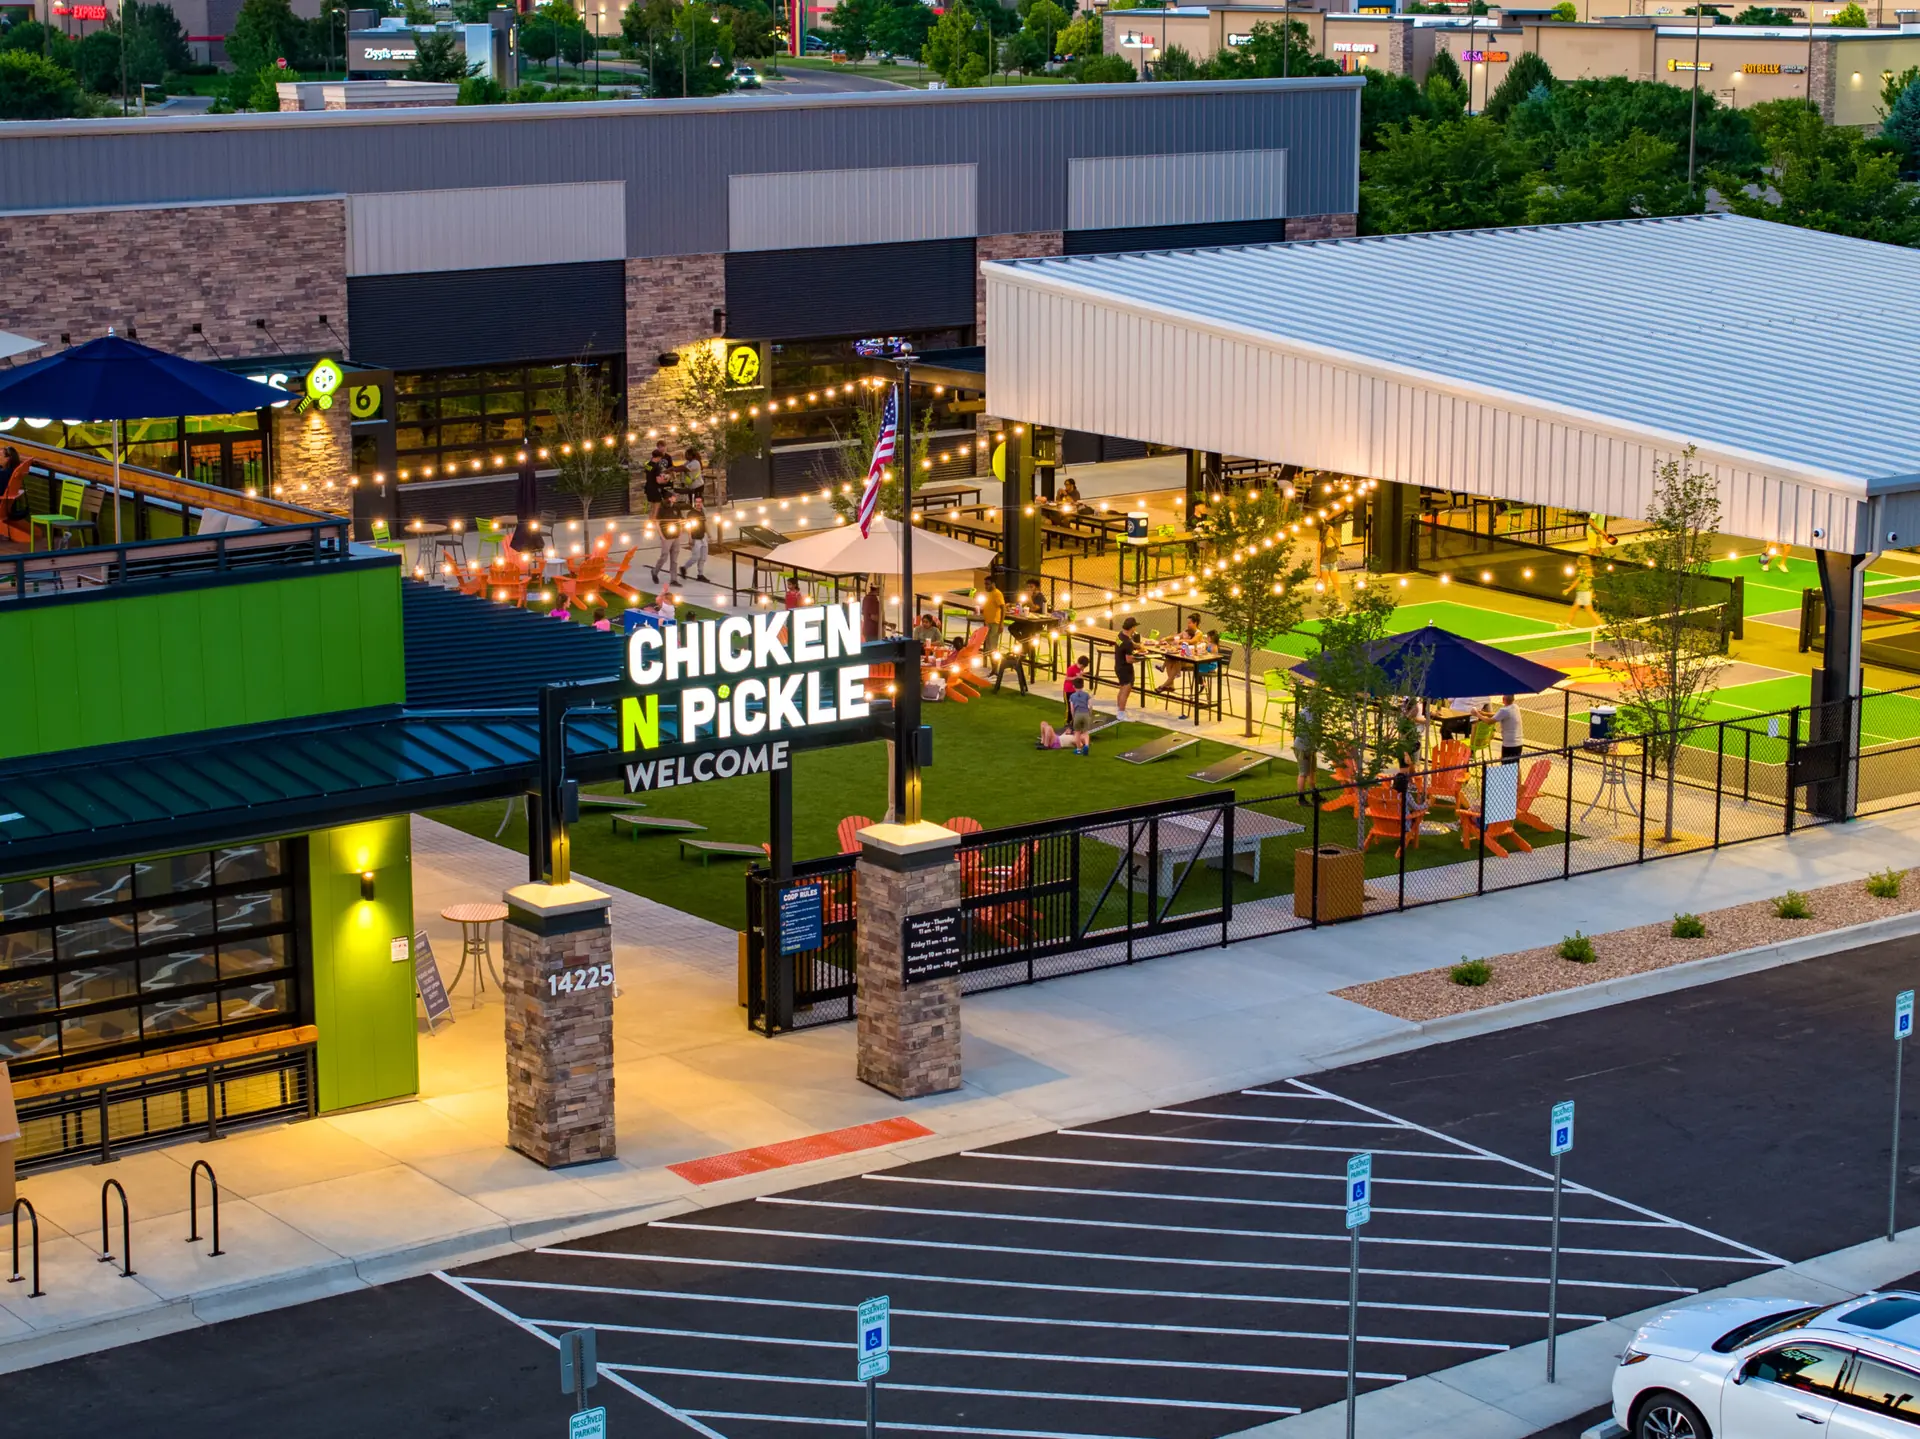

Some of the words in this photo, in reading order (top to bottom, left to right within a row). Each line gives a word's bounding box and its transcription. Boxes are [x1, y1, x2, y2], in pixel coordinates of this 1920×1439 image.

[73, 5, 106, 20] EXPRESS
[1333, 43, 1351, 52] FIVE
[1352, 43, 1376, 53] GUYS
[1743, 64, 1780, 74] POTBELLY
[356, 385, 371, 411] 6
[629, 602, 862, 685] CHICKEN
[622, 694, 659, 753] N
[626, 741, 789, 793] WELCOME
[783, 893, 799, 902] COOP
[800, 889, 817, 898] RULES
[912, 921, 930, 929] Monday
[934, 917, 955, 925] Thursday
[941, 925, 948, 933] pm
[909, 966, 926, 974] Sunday
[548, 964, 613, 996] 14225
[1350, 1159, 1369, 1170] RESERVED
[1351, 1167, 1368, 1178] PARKING
[861, 1303, 887, 1316] RESERVED
[862, 1312, 885, 1326] PARKING
[869, 1361, 879, 1369] VAN
[573, 1414, 603, 1429] RESERVED
[575, 1425, 601, 1438] PARKING
